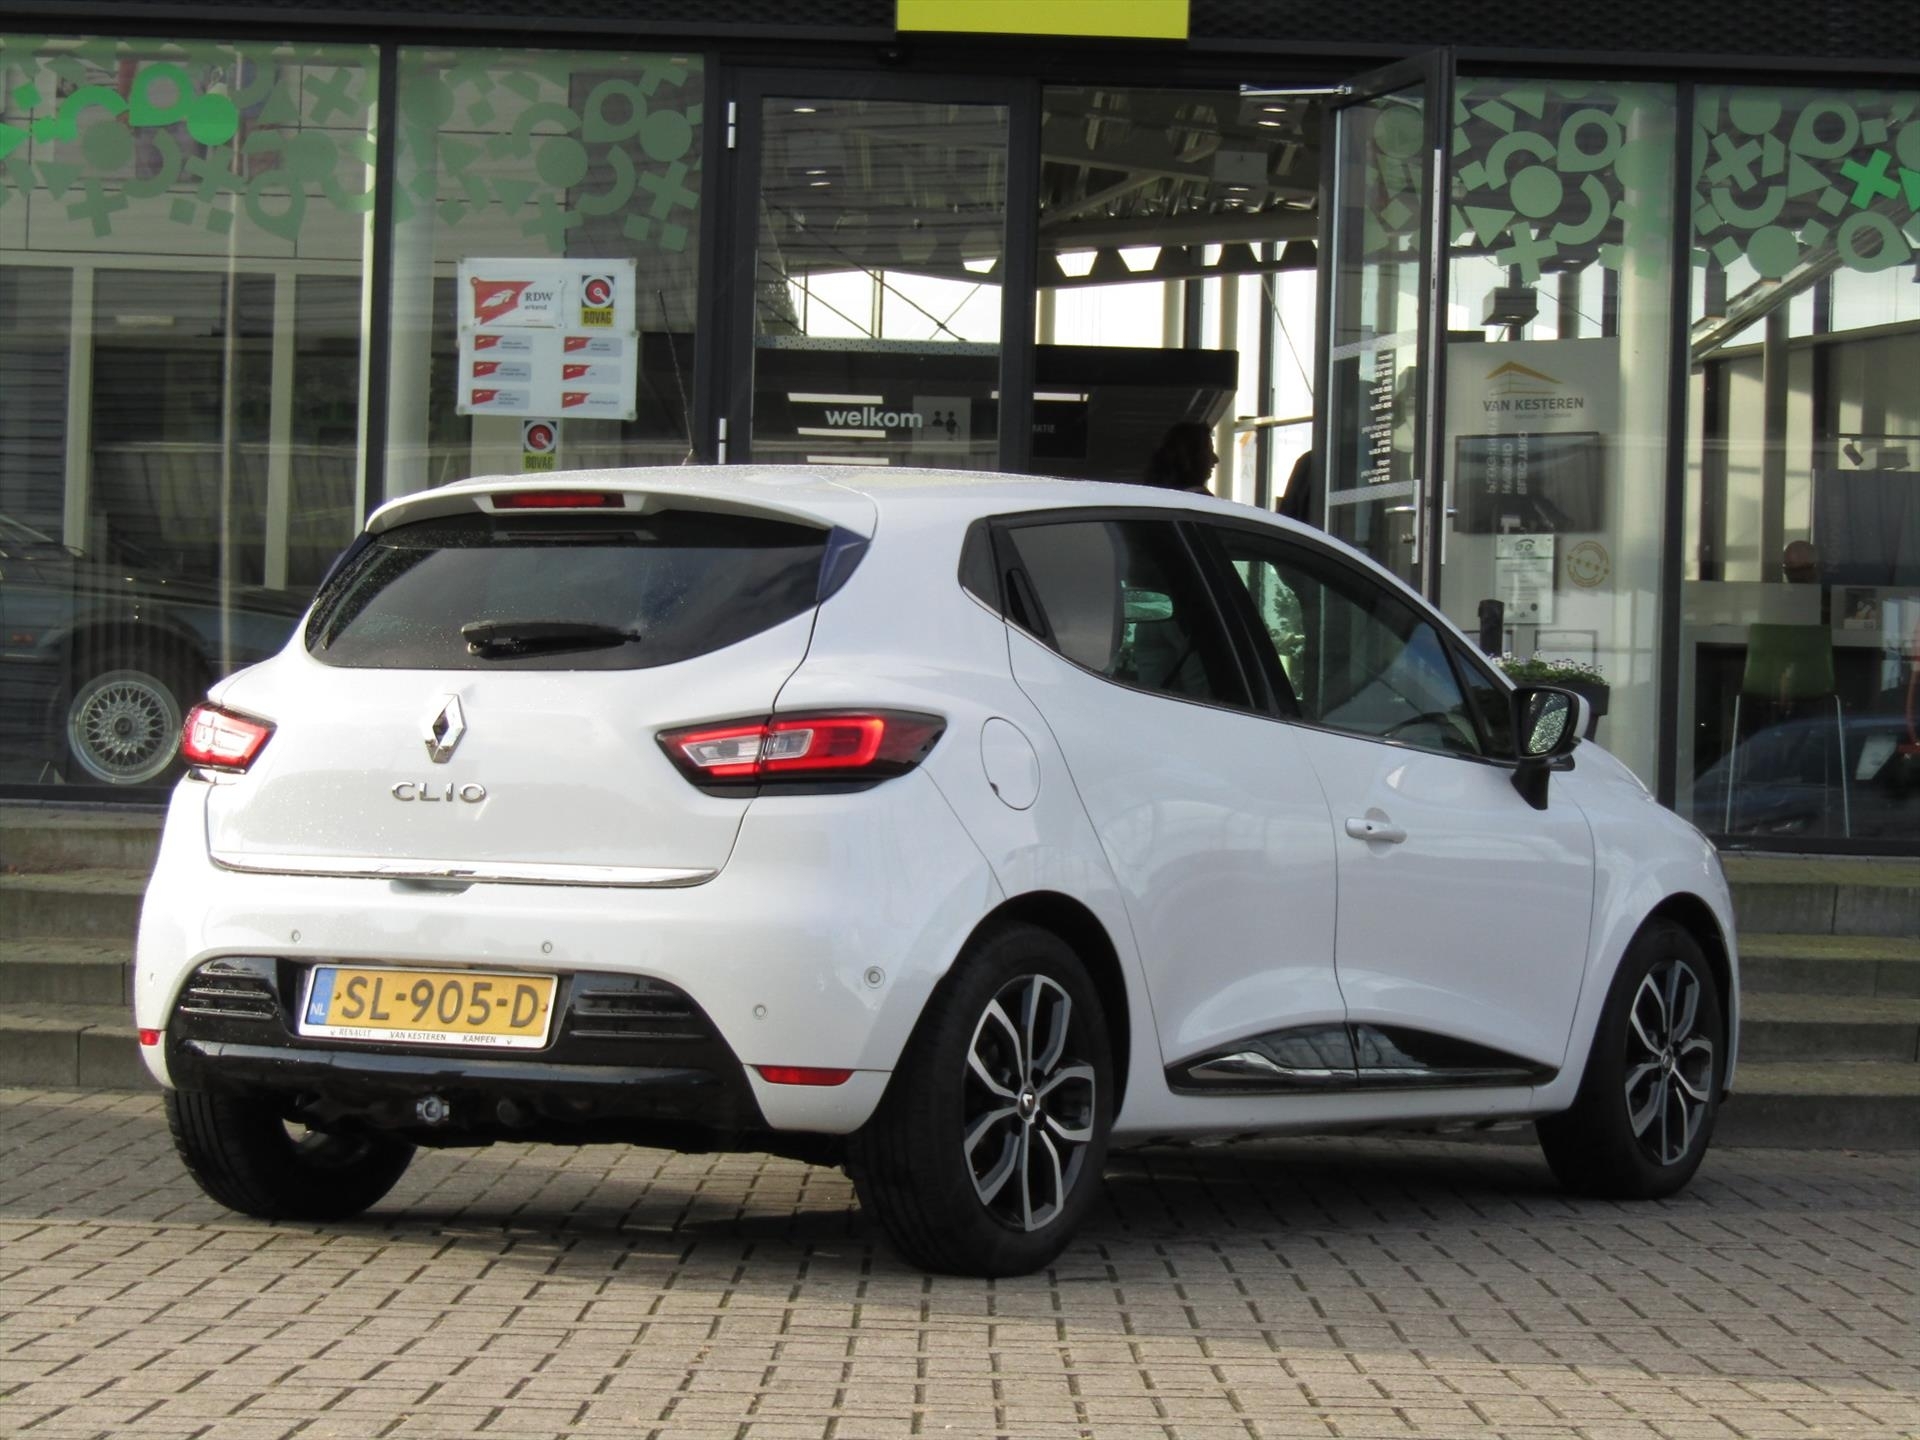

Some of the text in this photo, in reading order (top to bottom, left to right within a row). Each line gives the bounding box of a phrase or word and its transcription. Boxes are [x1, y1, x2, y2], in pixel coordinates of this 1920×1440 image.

[524, 291, 554, 302] RDW
[583, 311, 612, 324] BOVAG
[1482, 397, 1584, 412] VAN KESTEREN
[824, 406, 923, 428] welkom
[525, 456, 553, 470] BOVAG
[391, 782, 487, 803] CLIO
[341, 975, 540, 1029] SL-905-D
[310, 1003, 326, 1017] NL
[338, 1028, 497, 1045] RENAULT VAN KESTEREN KAMPEN
